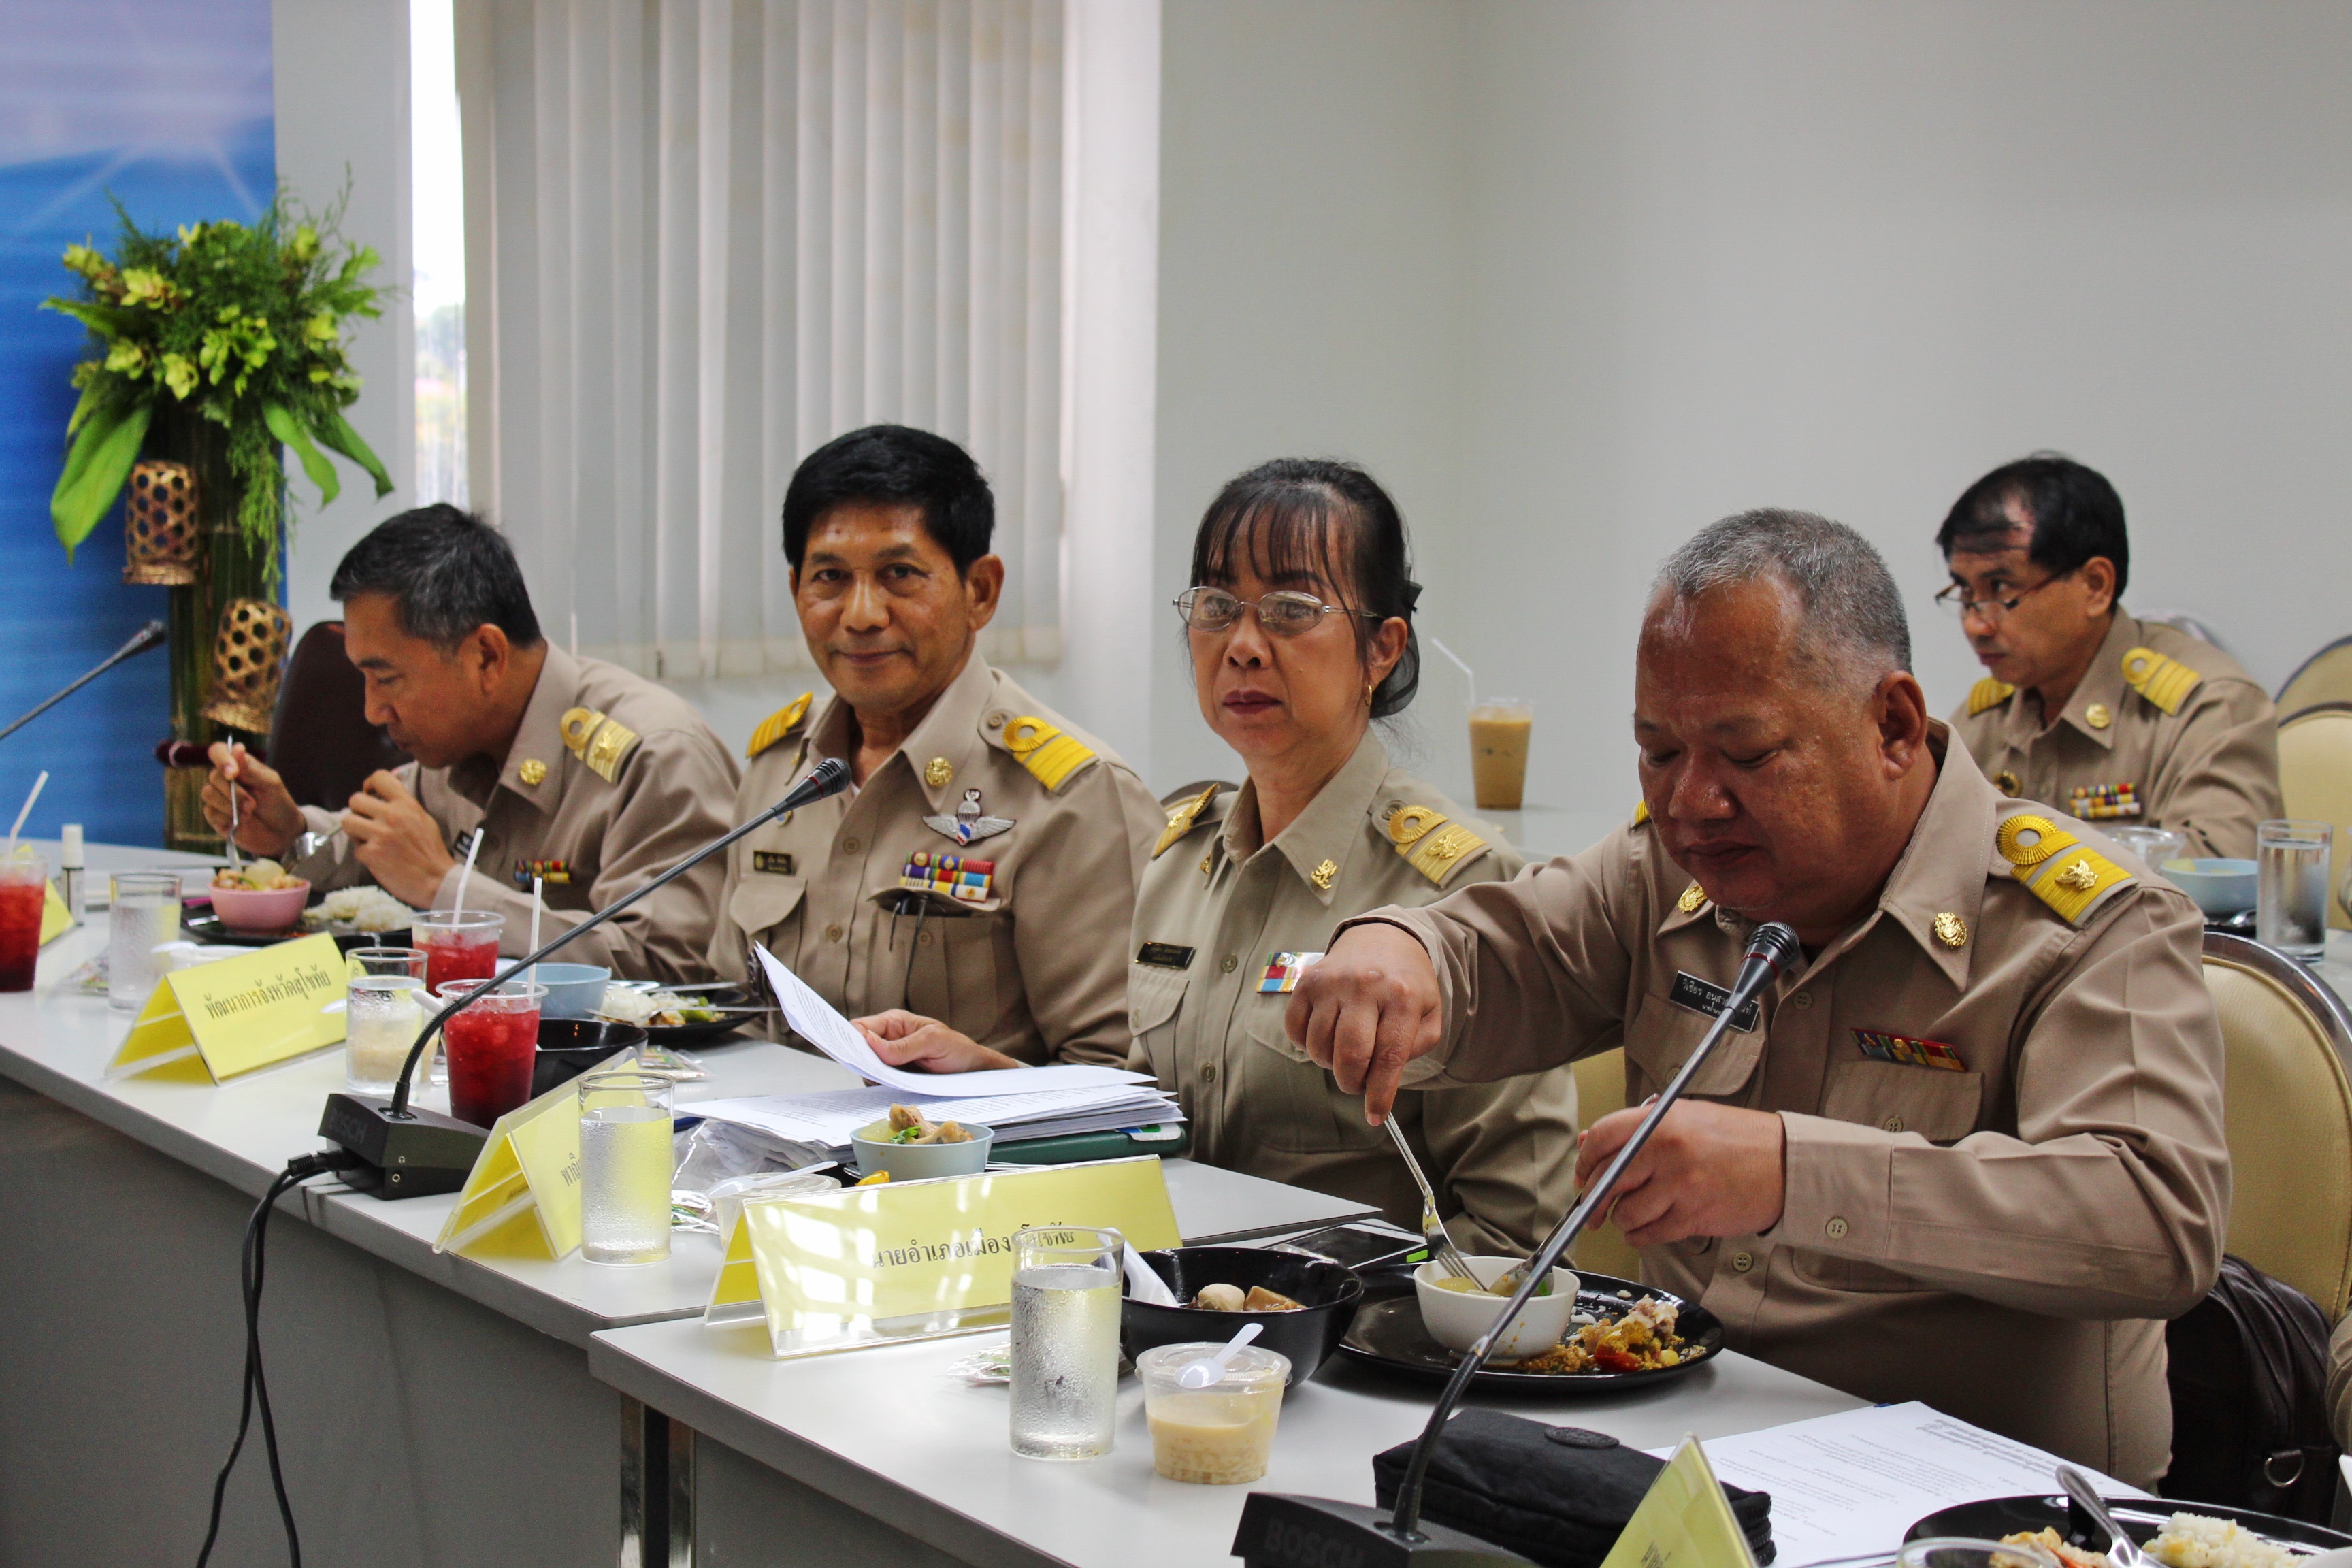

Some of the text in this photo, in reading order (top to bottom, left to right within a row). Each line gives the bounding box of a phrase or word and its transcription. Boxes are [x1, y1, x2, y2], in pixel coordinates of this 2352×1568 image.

[204, 963, 332, 1020] พัฒนาการจังหวัดสุโขทัย
[1264, 1516, 1364, 1568] BOSCH
